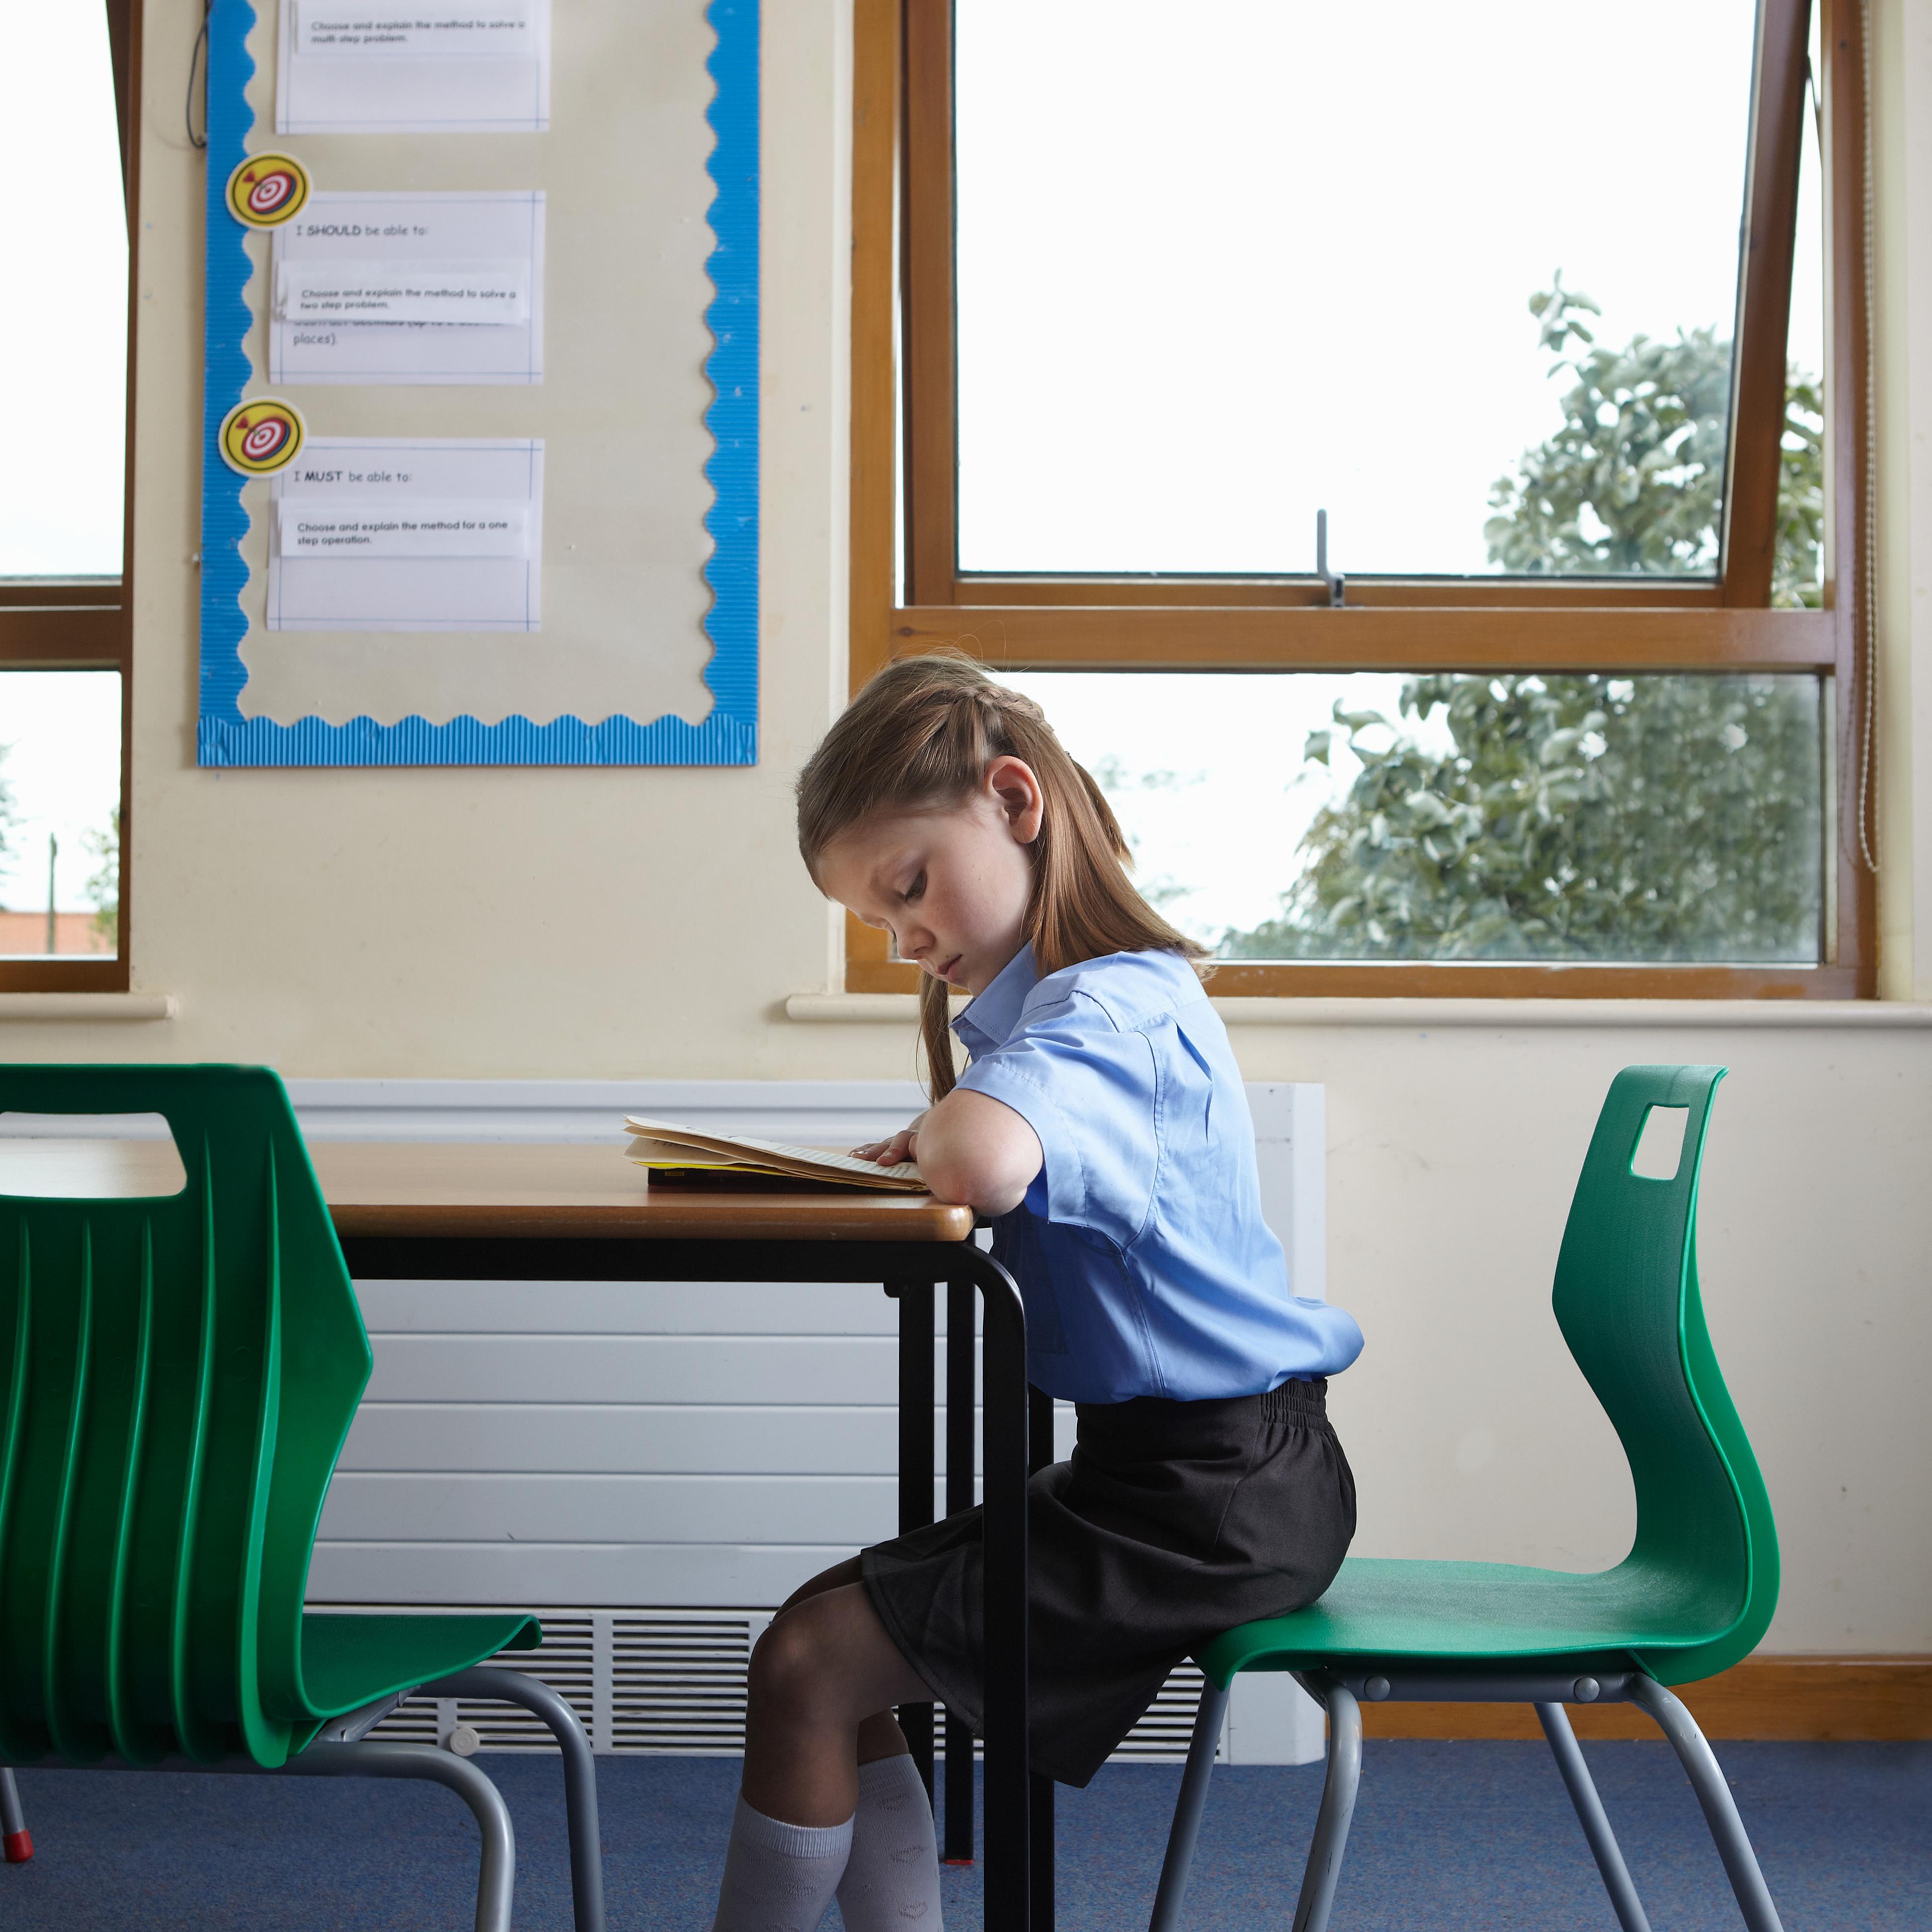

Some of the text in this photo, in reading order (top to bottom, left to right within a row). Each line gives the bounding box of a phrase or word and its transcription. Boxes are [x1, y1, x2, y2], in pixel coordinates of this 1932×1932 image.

[311, 21, 350, 30] Choose
[352, 21, 373, 30] and
[375, 21, 414, 32] explain
[415, 21, 432, 29] the
[434, 20, 474, 29] method
[476, 21, 487, 29] to
[489, 21, 516, 29] solve
[362, 34, 408, 44] problem.
[296, 224, 302, 236] I
[306, 224, 362, 236] SHOULD
[365, 225, 380, 236] be
[383, 225, 409, 236] able
[301, 289, 340, 298] Choose
[342, 289, 363, 297] and
[364, 288, 403, 299] explain
[405, 289, 422, 297] the
[424, 288, 464, 298] method
[466, 289, 477, 298] to
[479, 289, 507, 298] solve
[300, 300, 390, 310] two step problem.
[293, 470, 301, 482] I
[304, 470, 344, 482] MUST
[348, 471, 363, 482] be
[366, 470, 392, 482] able
[297, 522, 337, 532] Choose
[338, 522, 359, 531] and
[361, 521, 399, 533] explain
[401, 521, 418, 531] the
[420, 520, 460, 531] method
[462, 520, 476, 530] for
[478, 522, 486, 530] a
[297, 535, 373, 546] step operation.
